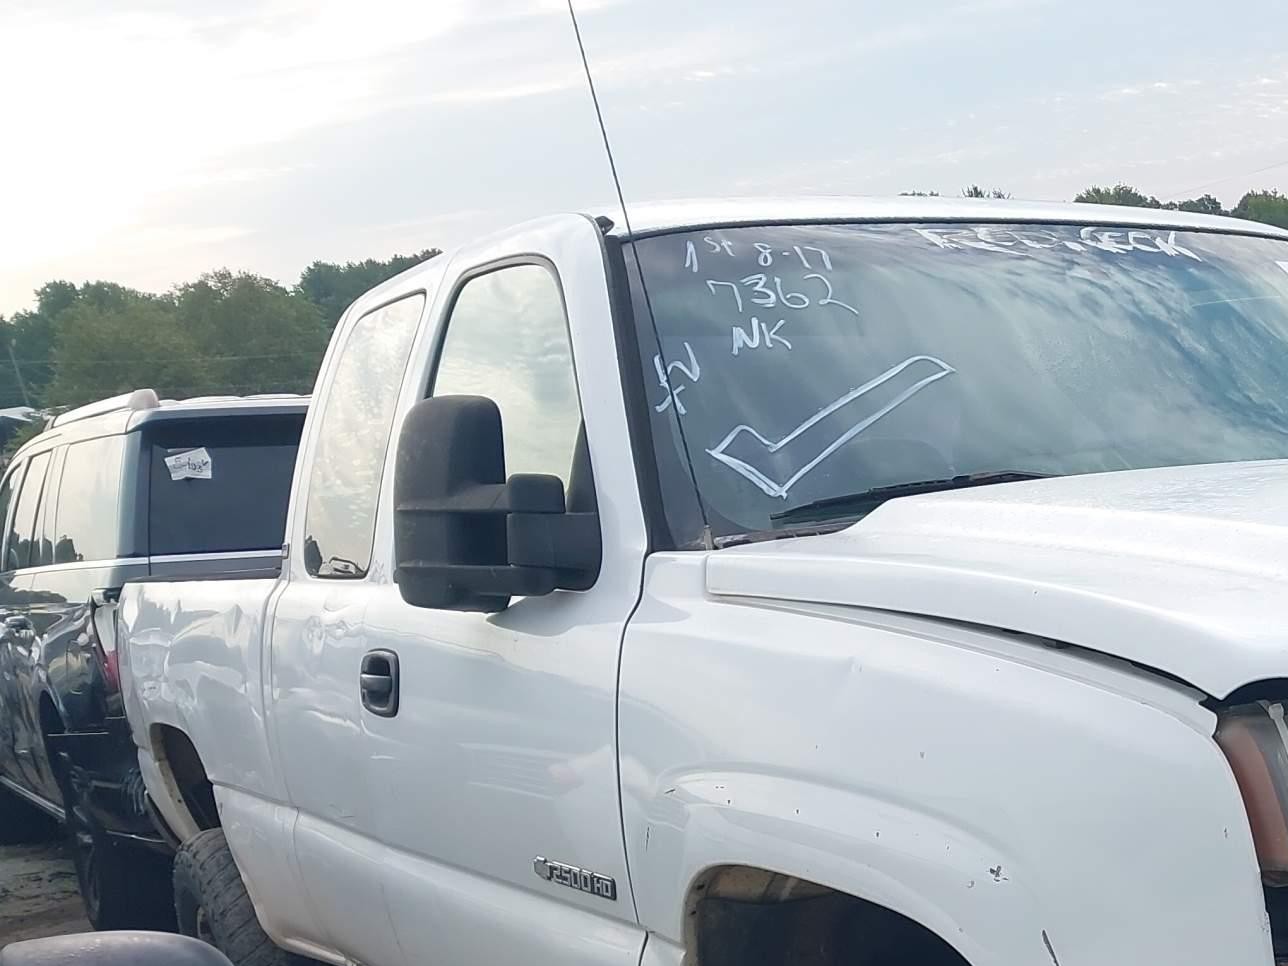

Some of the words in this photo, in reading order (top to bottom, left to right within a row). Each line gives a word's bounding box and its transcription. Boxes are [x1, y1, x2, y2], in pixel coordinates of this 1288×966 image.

[753, 242, 833, 271] 8-17
[706, 273, 860, 313] 7362
[730, 317, 792, 355] NK
